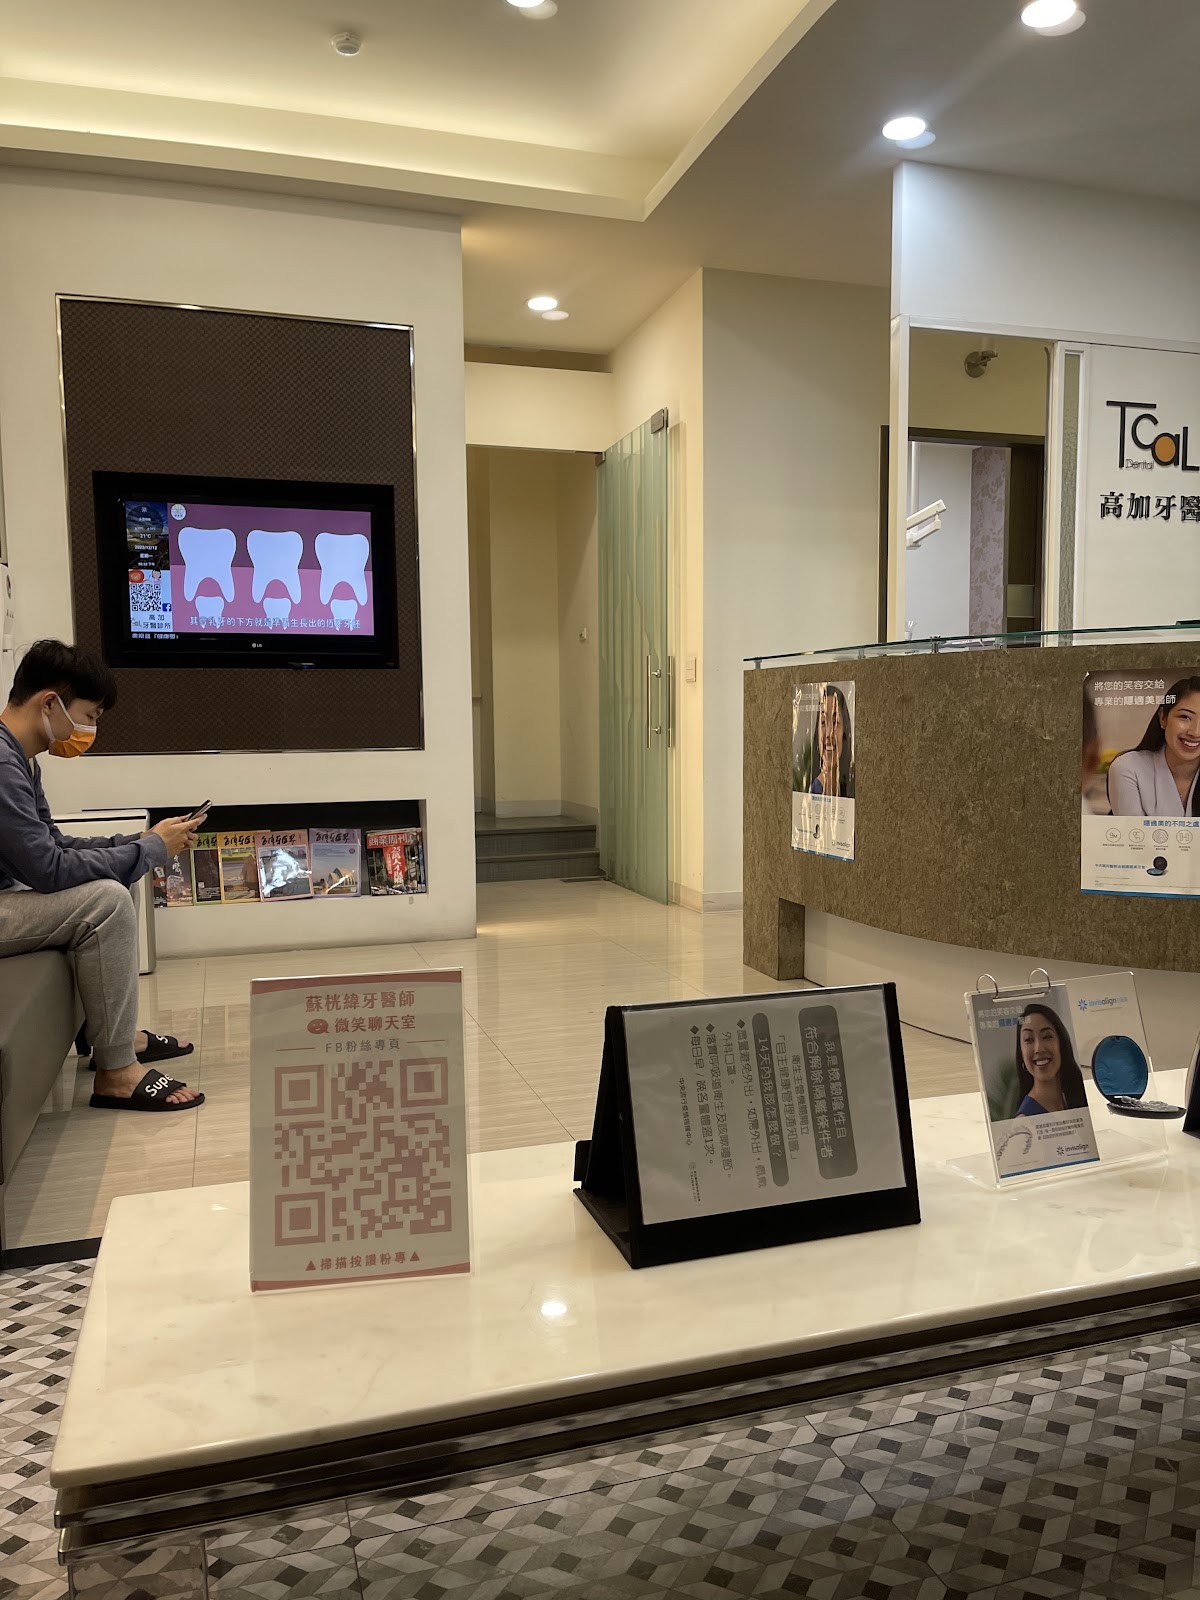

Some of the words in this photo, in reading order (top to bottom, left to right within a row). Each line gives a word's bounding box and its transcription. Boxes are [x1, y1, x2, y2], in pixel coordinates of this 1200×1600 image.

[142, 622, 171, 630] 牙醫診所
[1094, 679, 1165, 691] 將您的笑容交給
[369, 833, 408, 846] 商業周刊
[334, 1014, 416, 1034] 微笑聊天室
[325, 1038, 401, 1053] FB粉絲專頁
[803, 1026, 834, 1159] 符合解除隔離條件者
[824, 1040, 847, 1139] 我是檢驗陰性且
